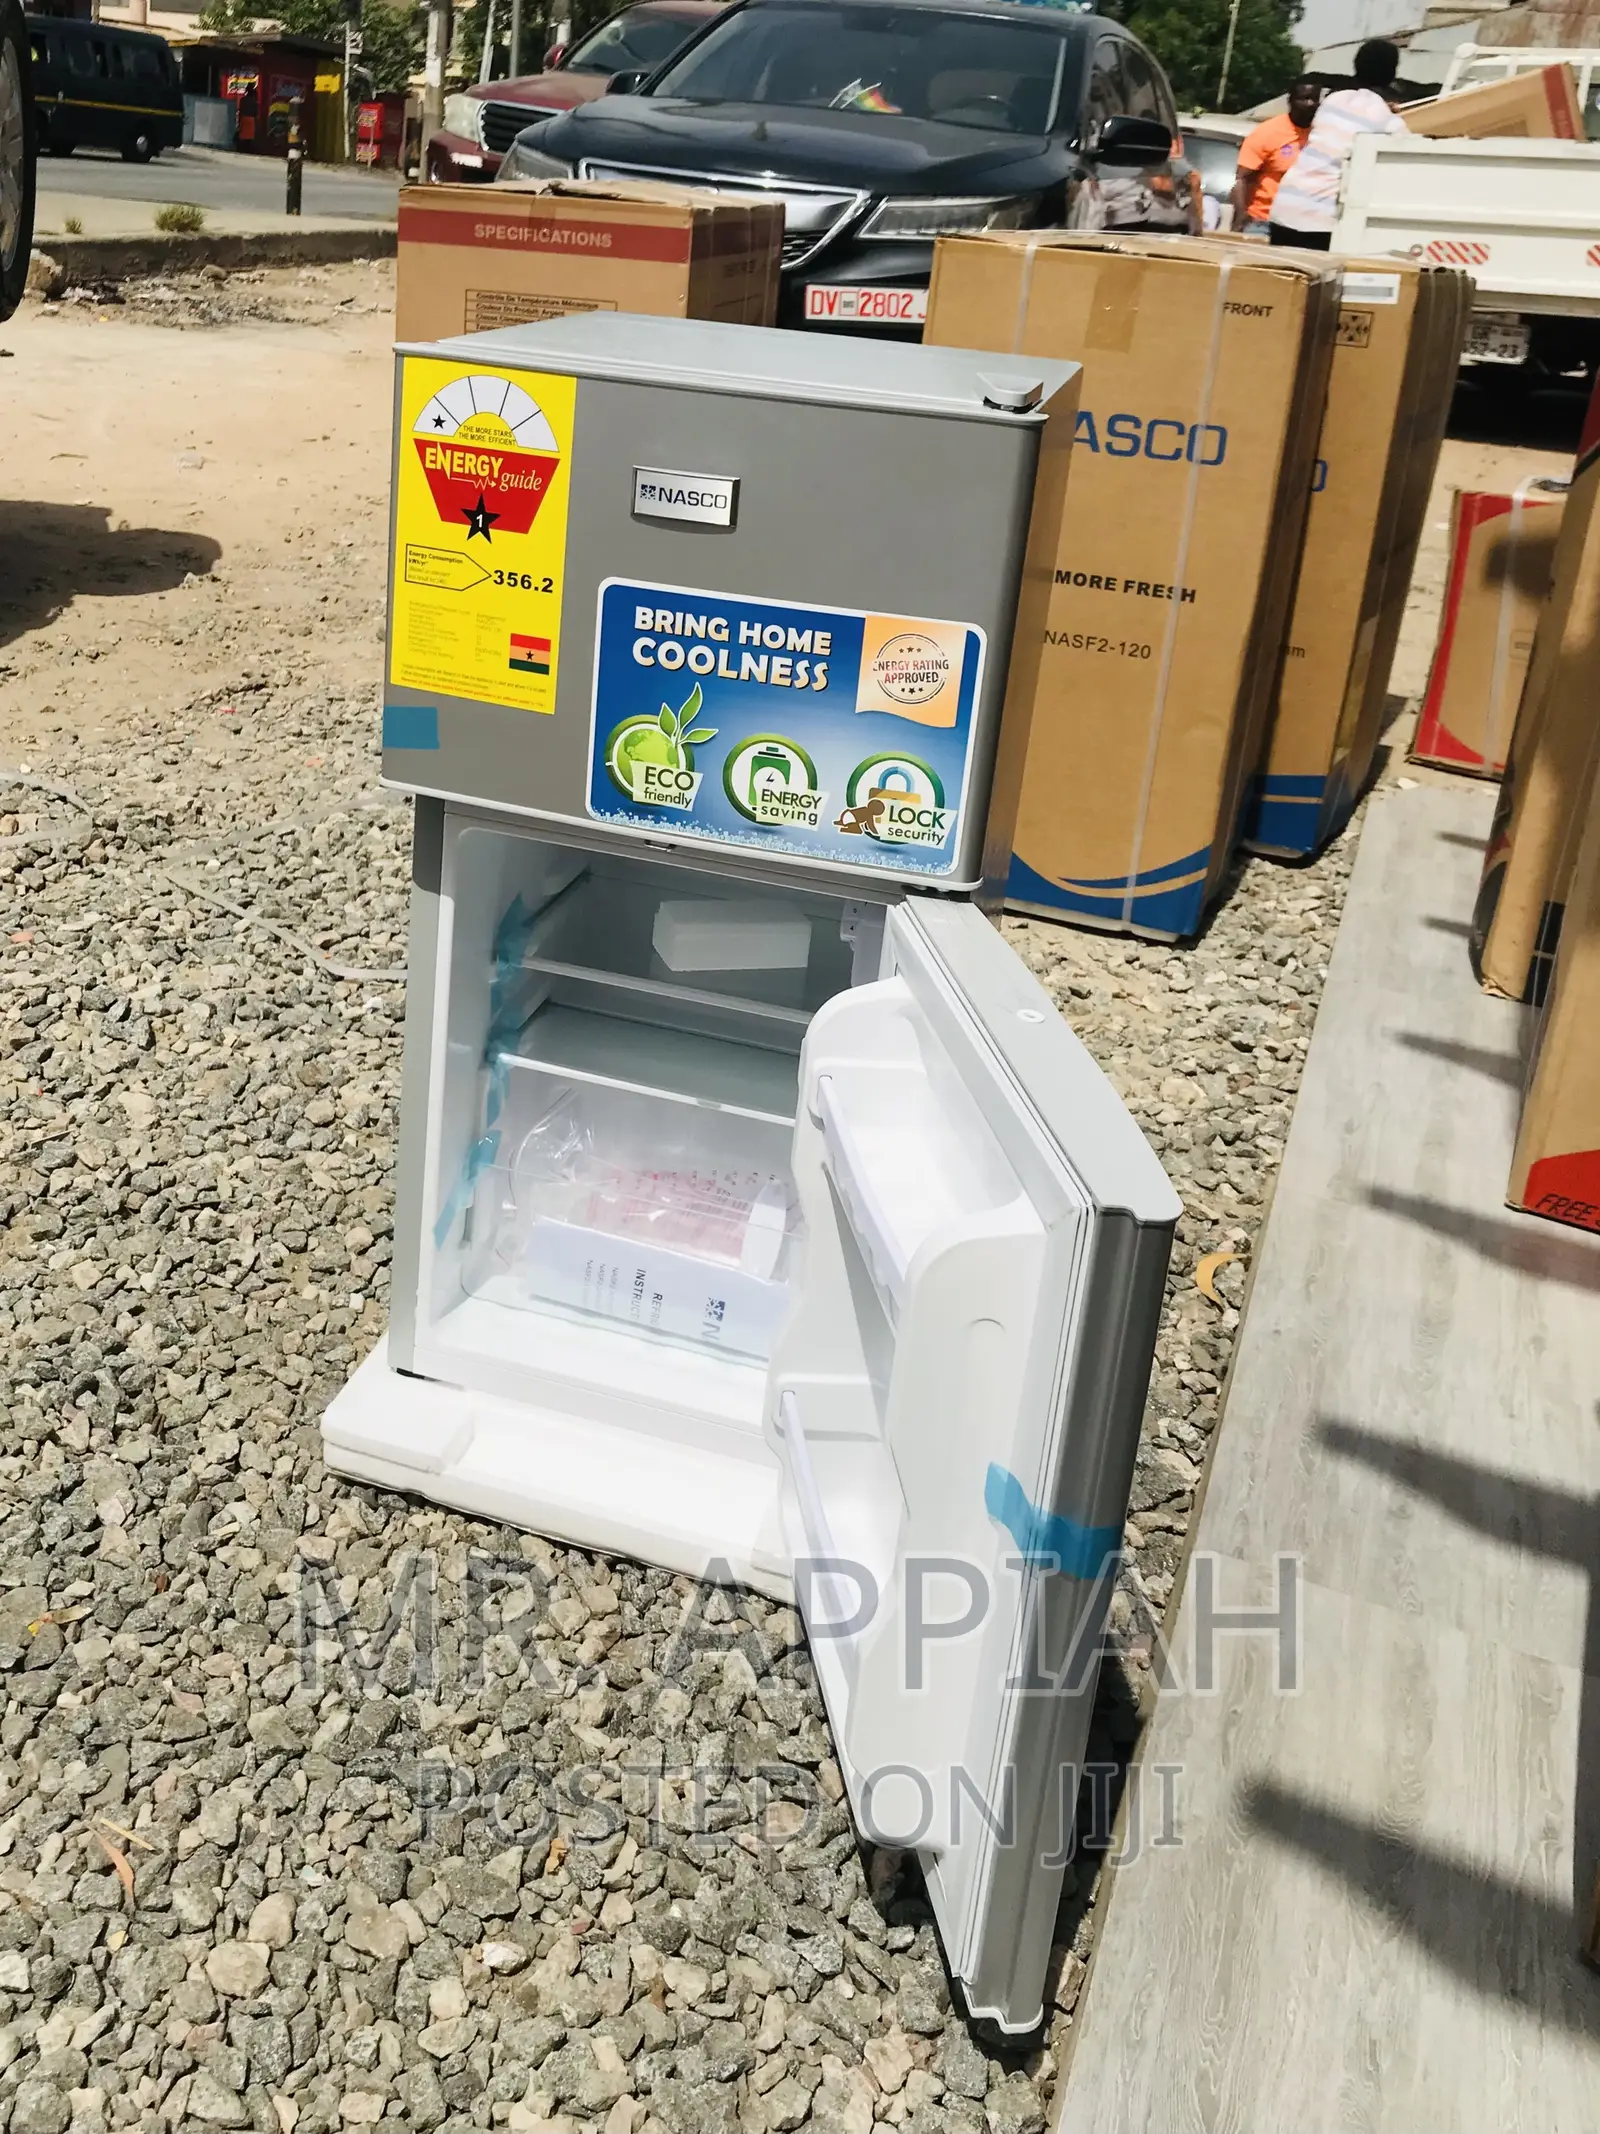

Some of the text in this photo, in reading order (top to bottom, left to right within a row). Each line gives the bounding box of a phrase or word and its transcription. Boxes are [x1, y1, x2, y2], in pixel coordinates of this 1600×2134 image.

[474, 223, 612, 248] SPECIFICATIONS
[811, 290, 914, 318] DV 2802
[1223, 302, 1273, 317] FRONT
[459, 432, 517, 446] THE MORE EFFICIENT
[463, 425, 513, 438] THE MORE STARS
[425, 442, 504, 480] ENERGY
[499, 469, 542, 492] guide
[659, 487, 727, 509] NASCO
[475, 513, 484, 528] 1
[493, 569, 554, 593] 356.2
[1054, 569, 1197, 603] MORE FRESH
[634, 606, 832, 657] BRING HOME
[1043, 629, 1151, 660] NASF2-120
[632, 636, 830, 692] COOLNESS
[912, 659, 950, 672] RATING
[884, 671, 940, 684] APPROVED
[644, 765, 695, 791] ECO
[643, 786, 692, 811] friendly
[760, 789, 822, 811] ENERGY
[760, 805, 818, 826] saving
[888, 806, 946, 830] LOCK
[887, 825, 945, 845] security
